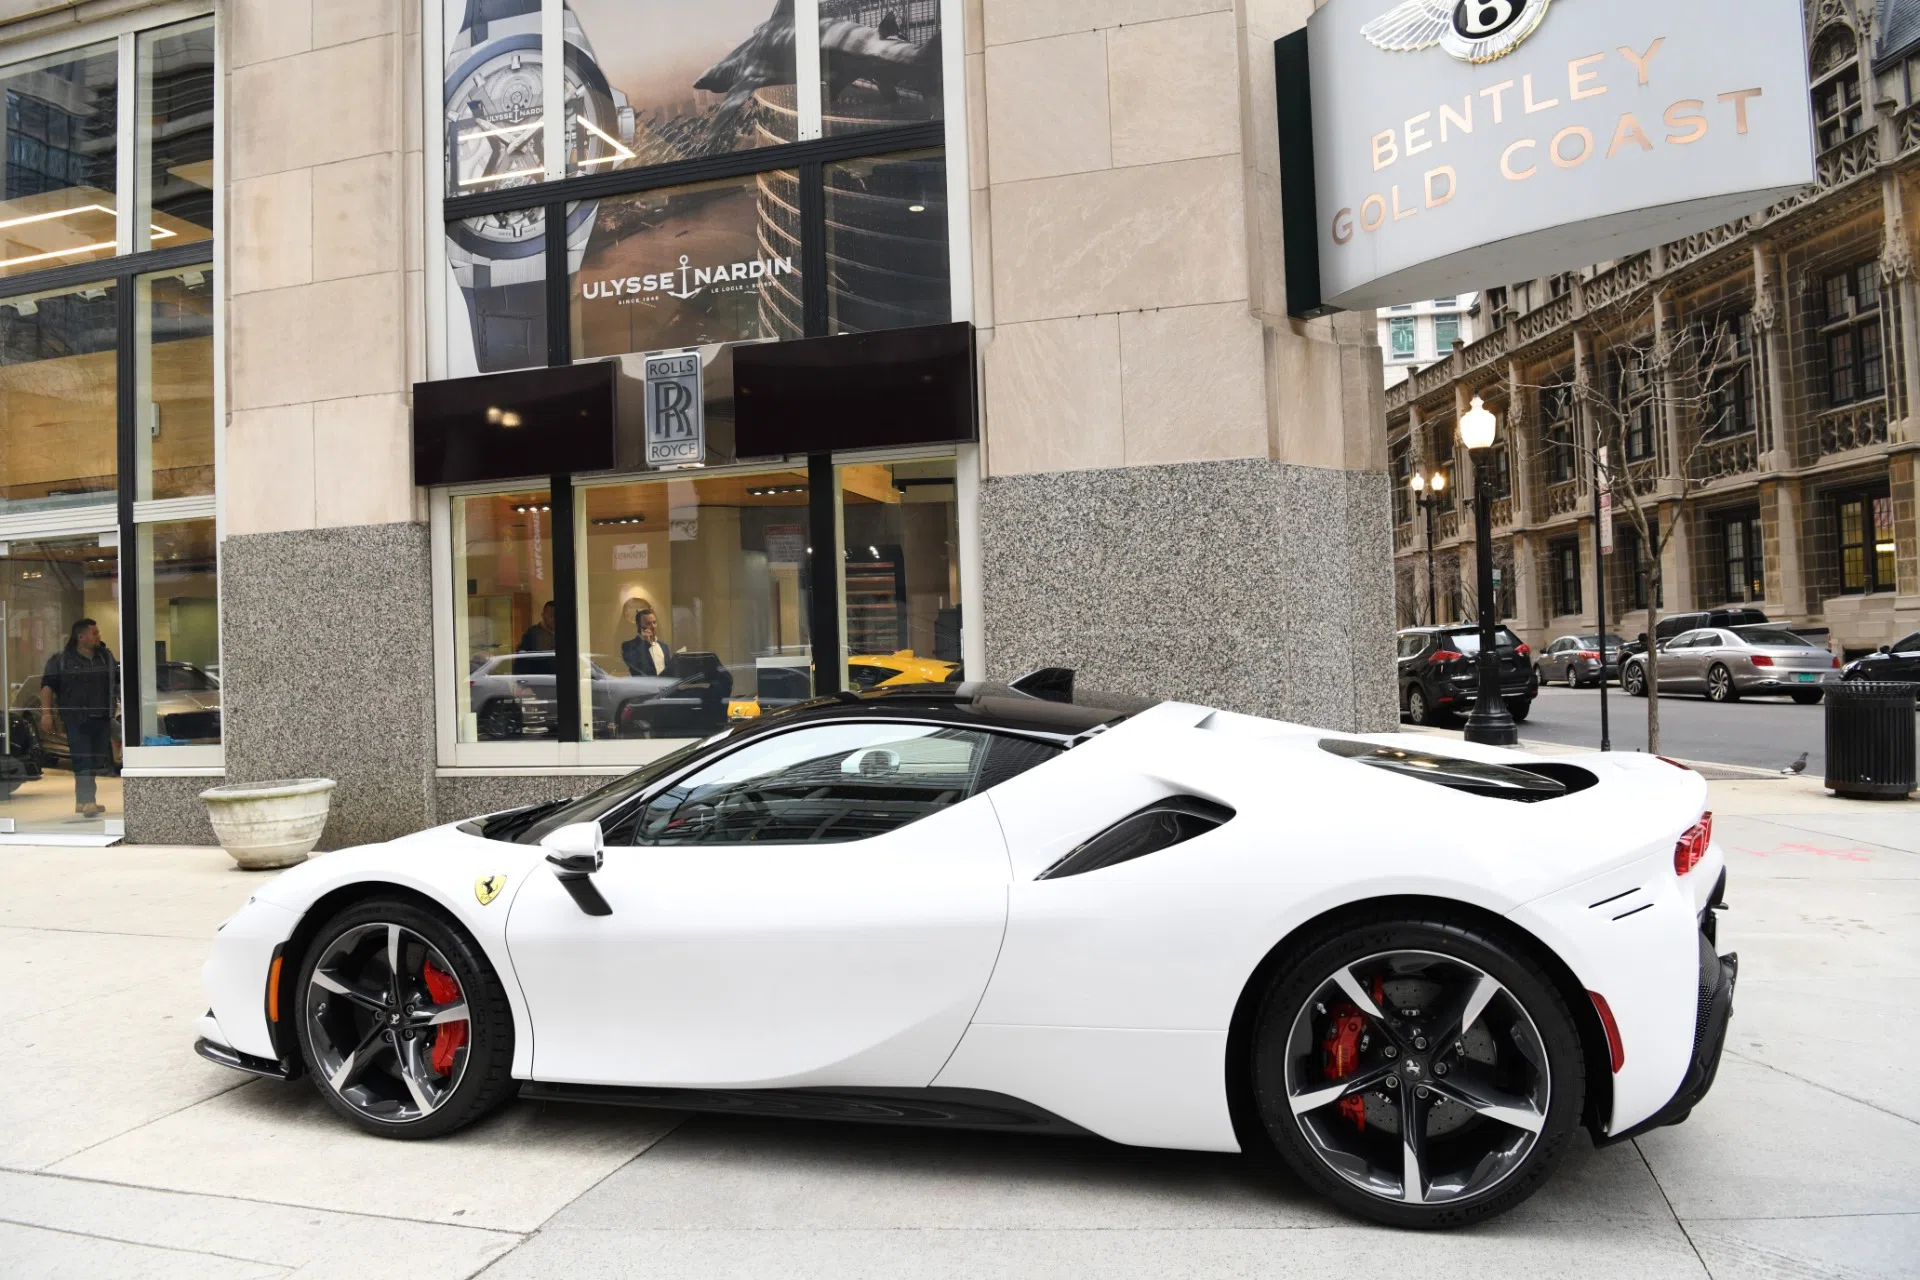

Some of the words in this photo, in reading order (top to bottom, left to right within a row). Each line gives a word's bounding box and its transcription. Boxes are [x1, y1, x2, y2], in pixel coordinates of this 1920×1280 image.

[486, 112, 513, 122] ULYSSE
[1372, 36, 1666, 172] BENTLEY
[1332, 165, 1457, 245] GOLD
[1499, 87, 1762, 181] COAST
[583, 272, 674, 299] ULYSSE
[695, 257, 792, 286] NARDIN
[649, 359, 694, 376] ROLLS
[654, 381, 694, 438] RR
[651, 443, 697, 459] ROYCE
